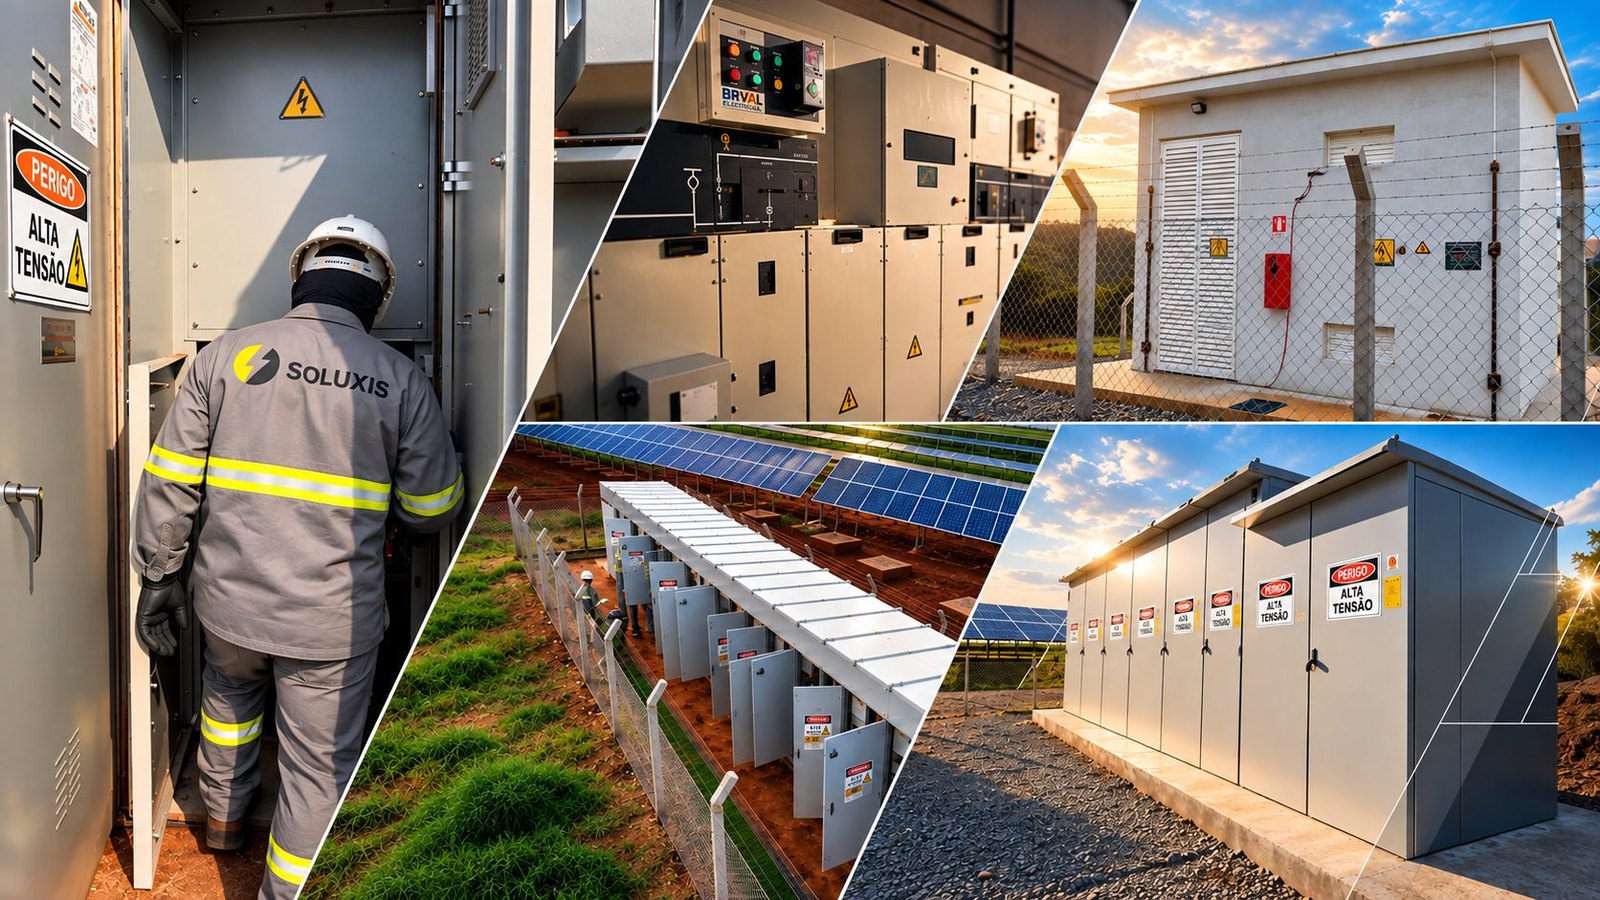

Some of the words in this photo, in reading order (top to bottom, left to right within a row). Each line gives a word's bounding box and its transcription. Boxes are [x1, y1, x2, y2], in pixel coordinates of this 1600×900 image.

[722, 87, 763, 106] BRVAL
[31, 156, 76, 202] PERIGO
[28, 212, 60, 249] ALTA
[15, 245, 66, 286] TENSÃO
[286, 361, 390, 399] SOLUXIS
[1337, 565, 1368, 581] PERIGO
[1340, 585, 1364, 600] ALTA
[1266, 600, 1283, 611] ALTA
[1332, 597, 1373, 615] TENSÃO
[1261, 609, 1289, 623] TENSÃO
